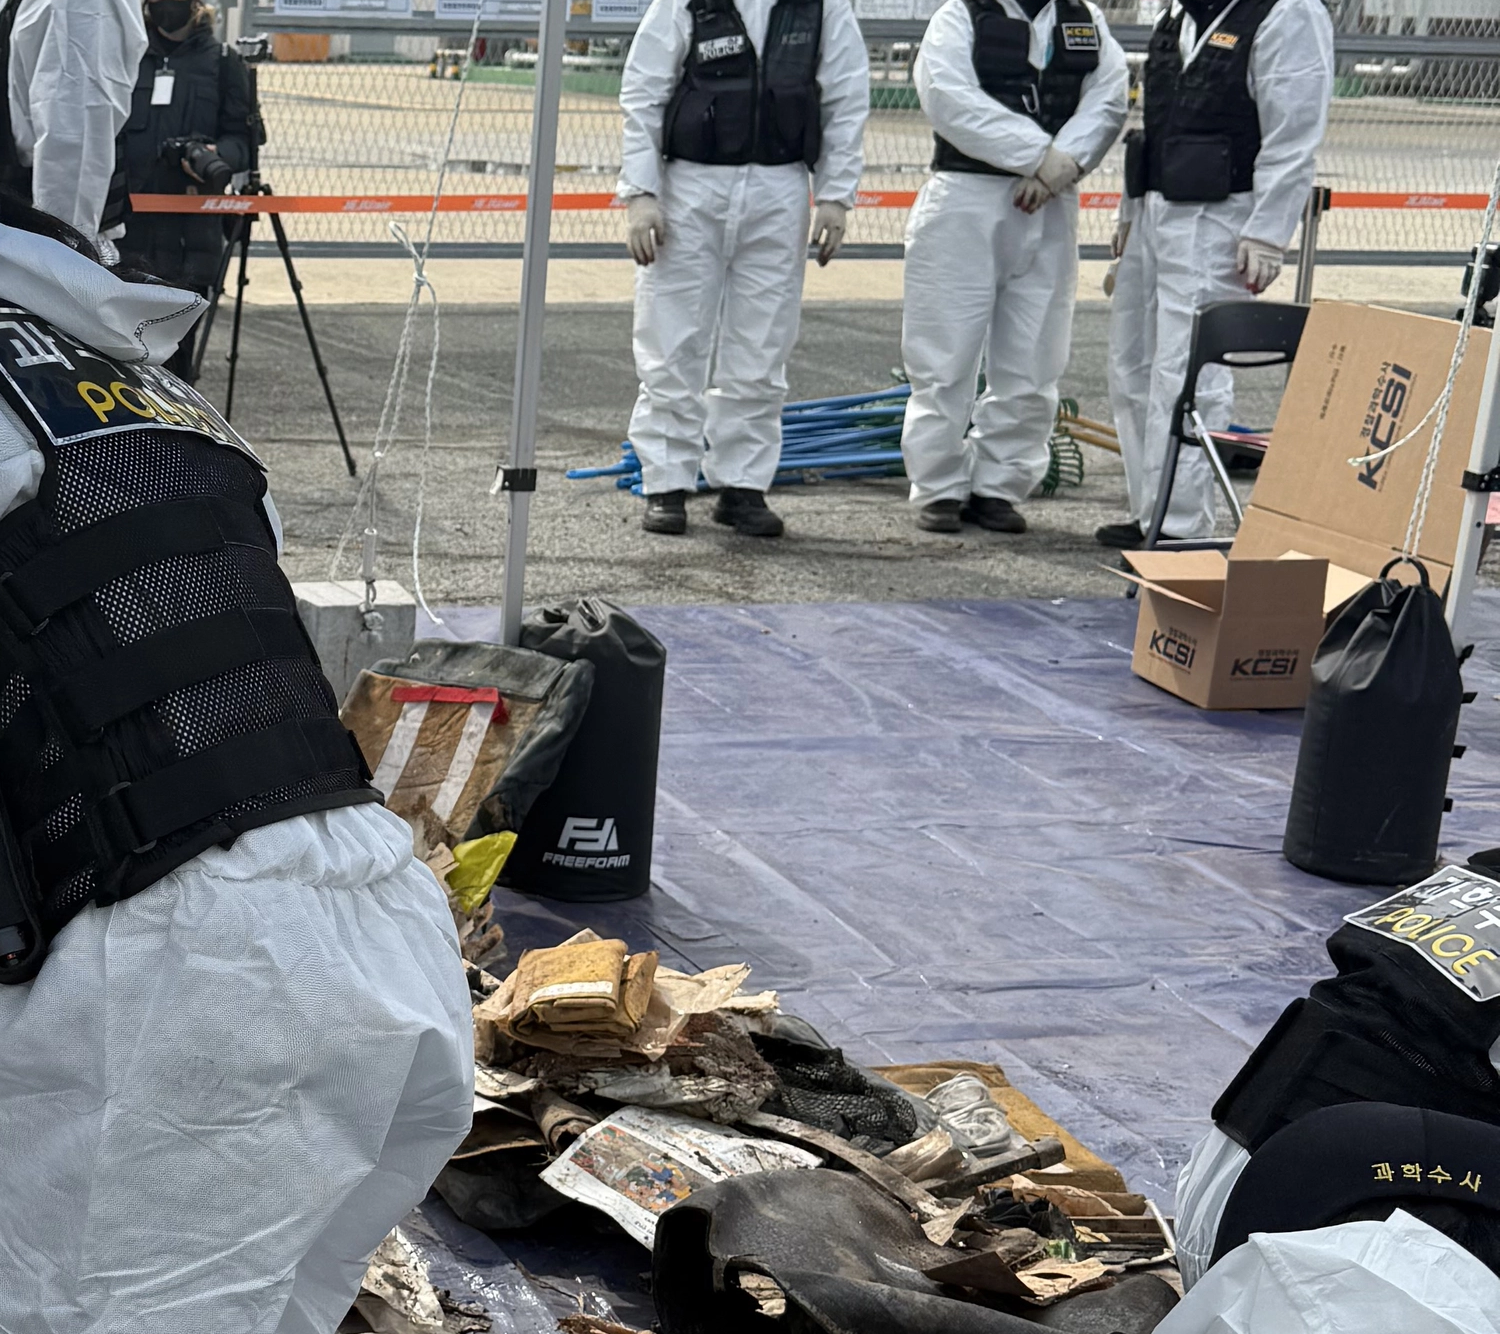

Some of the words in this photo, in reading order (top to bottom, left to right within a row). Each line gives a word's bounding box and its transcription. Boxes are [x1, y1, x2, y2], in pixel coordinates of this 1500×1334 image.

[1357, 363, 1412, 490] KCSI
[1149, 629, 1196, 669] KCSI
[1230, 655, 1299, 676] KCSI
[1374, 907, 1498, 975] POLICE
[1370, 1161, 1482, 1194] 과학수사
